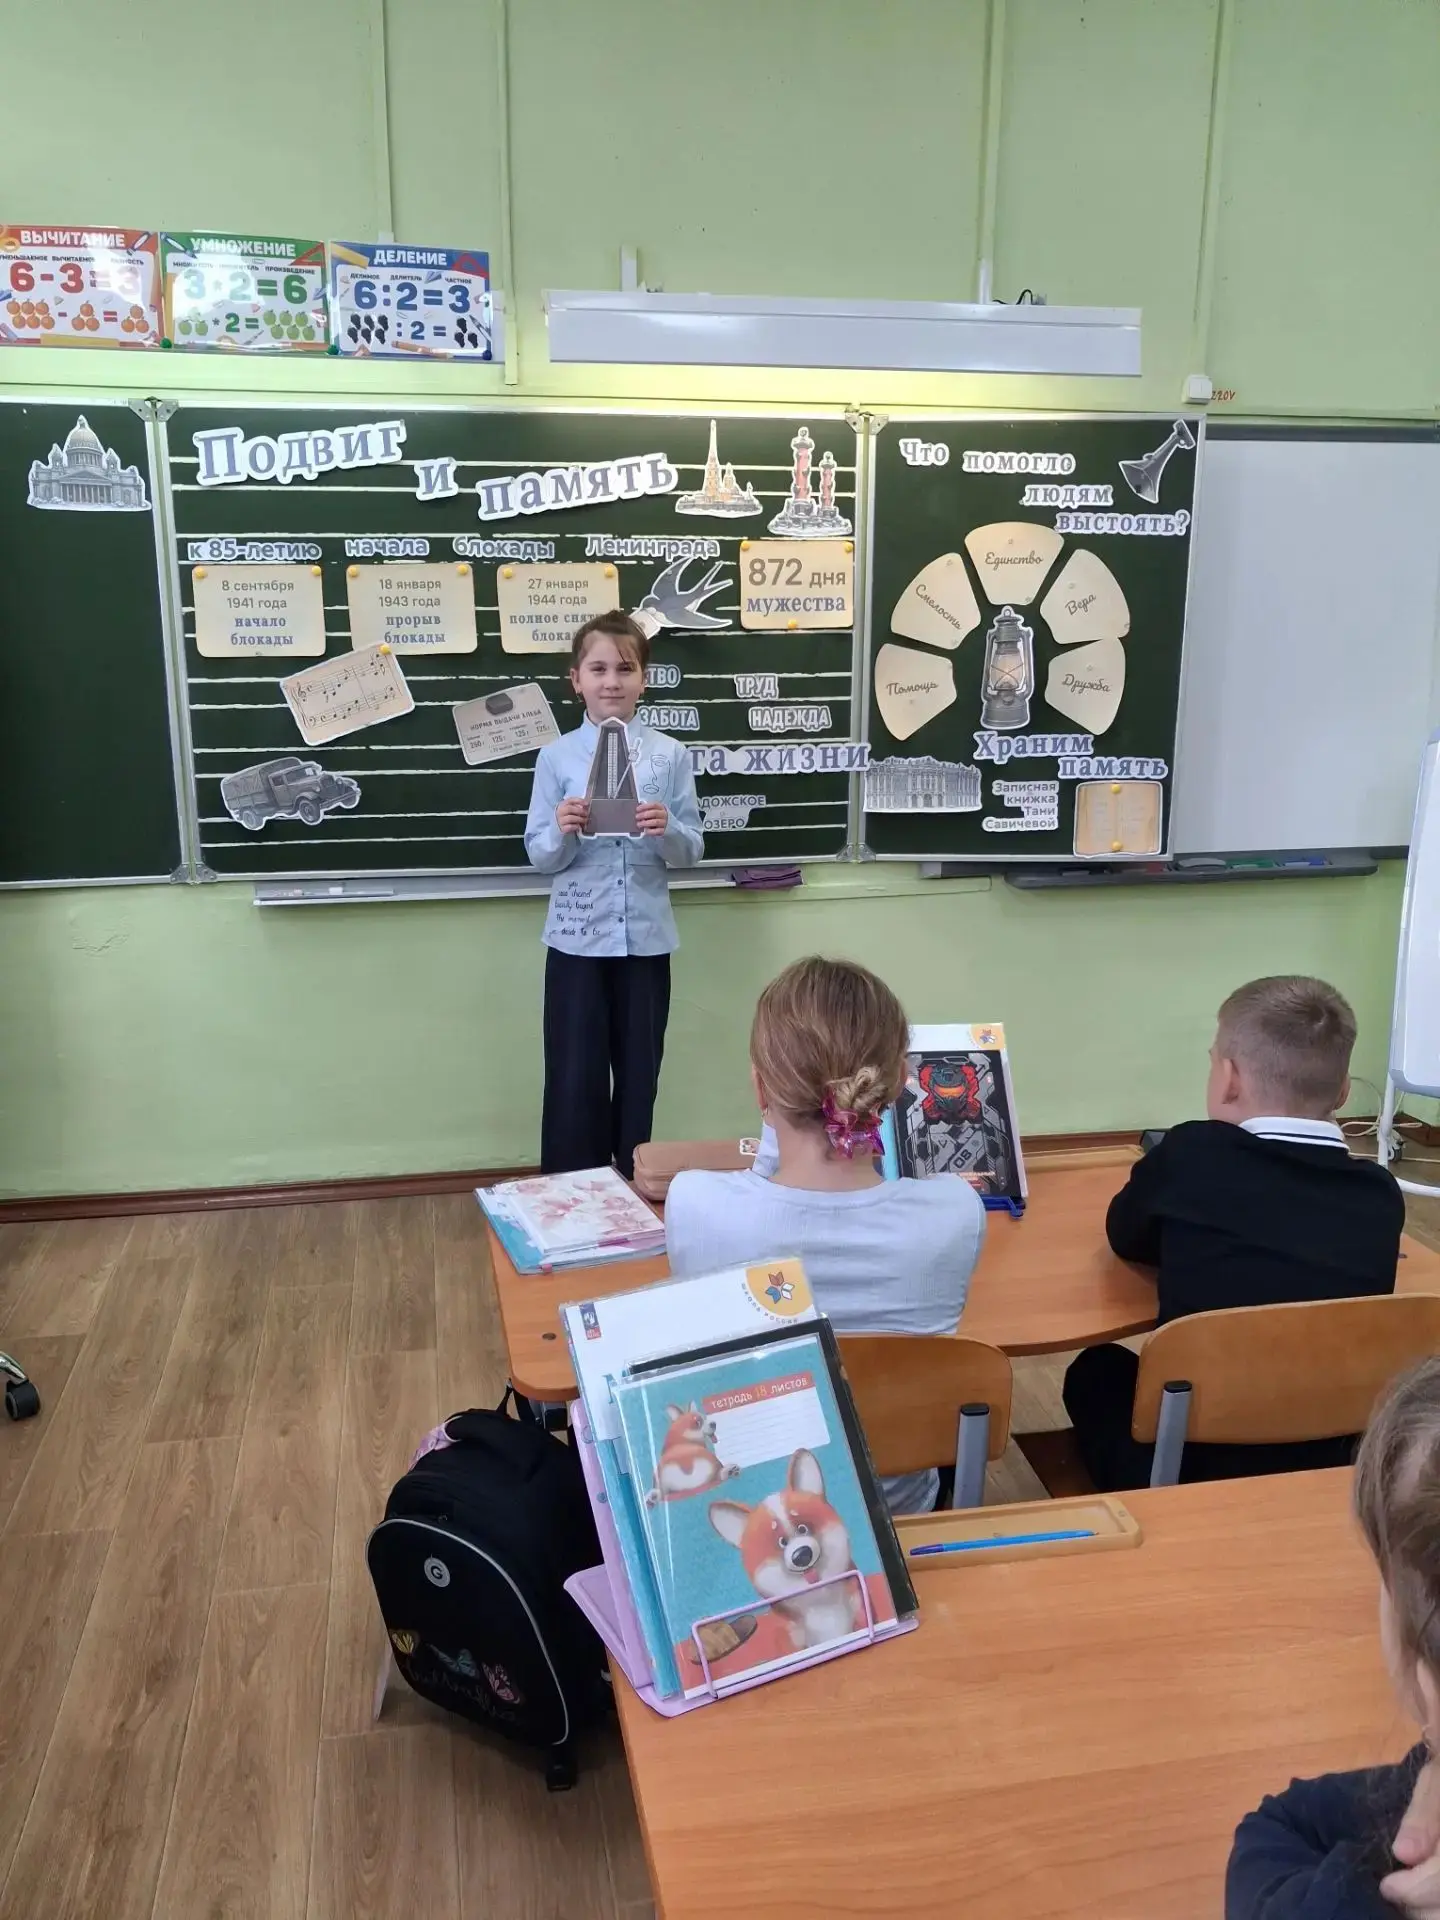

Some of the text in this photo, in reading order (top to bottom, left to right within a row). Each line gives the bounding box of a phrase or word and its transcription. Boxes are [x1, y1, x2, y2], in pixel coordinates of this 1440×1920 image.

[20, 230, 125, 247] ВЫЧИТАНИЕ
[190, 238, 296, 257] УМНОЖЕНИЕ
[374, 250, 447, 266] ДЕЛЕНИЕ
[903, 441, 1074, 472] Что помогло
[202, 426, 673, 514] Подвиг и память
[1026, 485, 1111, 505] людям
[1057, 511, 1188, 534] выстоять?
[209, 540, 320, 559] 85-летию
[347, 539, 428, 555] начала
[454, 537, 554, 558] блокады
[587, 537, 719, 558] Ленинграда
[985, 552, 1044, 571] Единство
[748, 558, 846, 588] 872 дня
[222, 581, 294, 594] 8 сентября
[379, 579, 442, 593] 18 января
[528, 579, 589, 591] 27 января
[227, 597, 287, 610] 1941 года
[379, 596, 441, 610] 1943 года
[528, 595, 587, 606] 1944 года
[746, 596, 846, 616] мужества
[915, 584, 963, 630] Смелость
[1065, 593, 1097, 615] Вера
[235, 616, 286, 628] начало
[386, 615, 441, 627] прорыв
[510, 615, 558, 624] полное
[231, 633, 293, 646] блокады
[384, 632, 445, 644] блокады
[532, 629, 576, 641] блока
[736, 676, 777, 698] ТРУД
[886, 681, 939, 696] Помощь
[1062, 674, 1113, 693] Дружба
[639, 708, 698, 727] ЗАБОТА
[751, 707, 831, 731] НАДЕЖДА
[976, 733, 1092, 760] Храним
[744, 745, 868, 773] жизни
[1060, 758, 1165, 777] память
[995, 782, 1056, 795] Записная
[698, 796, 765, 808] ДОЖСКОЕ
[1006, 795, 1056, 804] книжка
[1024, 805, 1056, 816] Тани
[704, 818, 745, 830] ОЗЕРО
[985, 817, 1056, 830] Савичевой
[712, 1378, 807, 1409] тетрадь 18 листов
[431, 1565, 443, 1580] G
